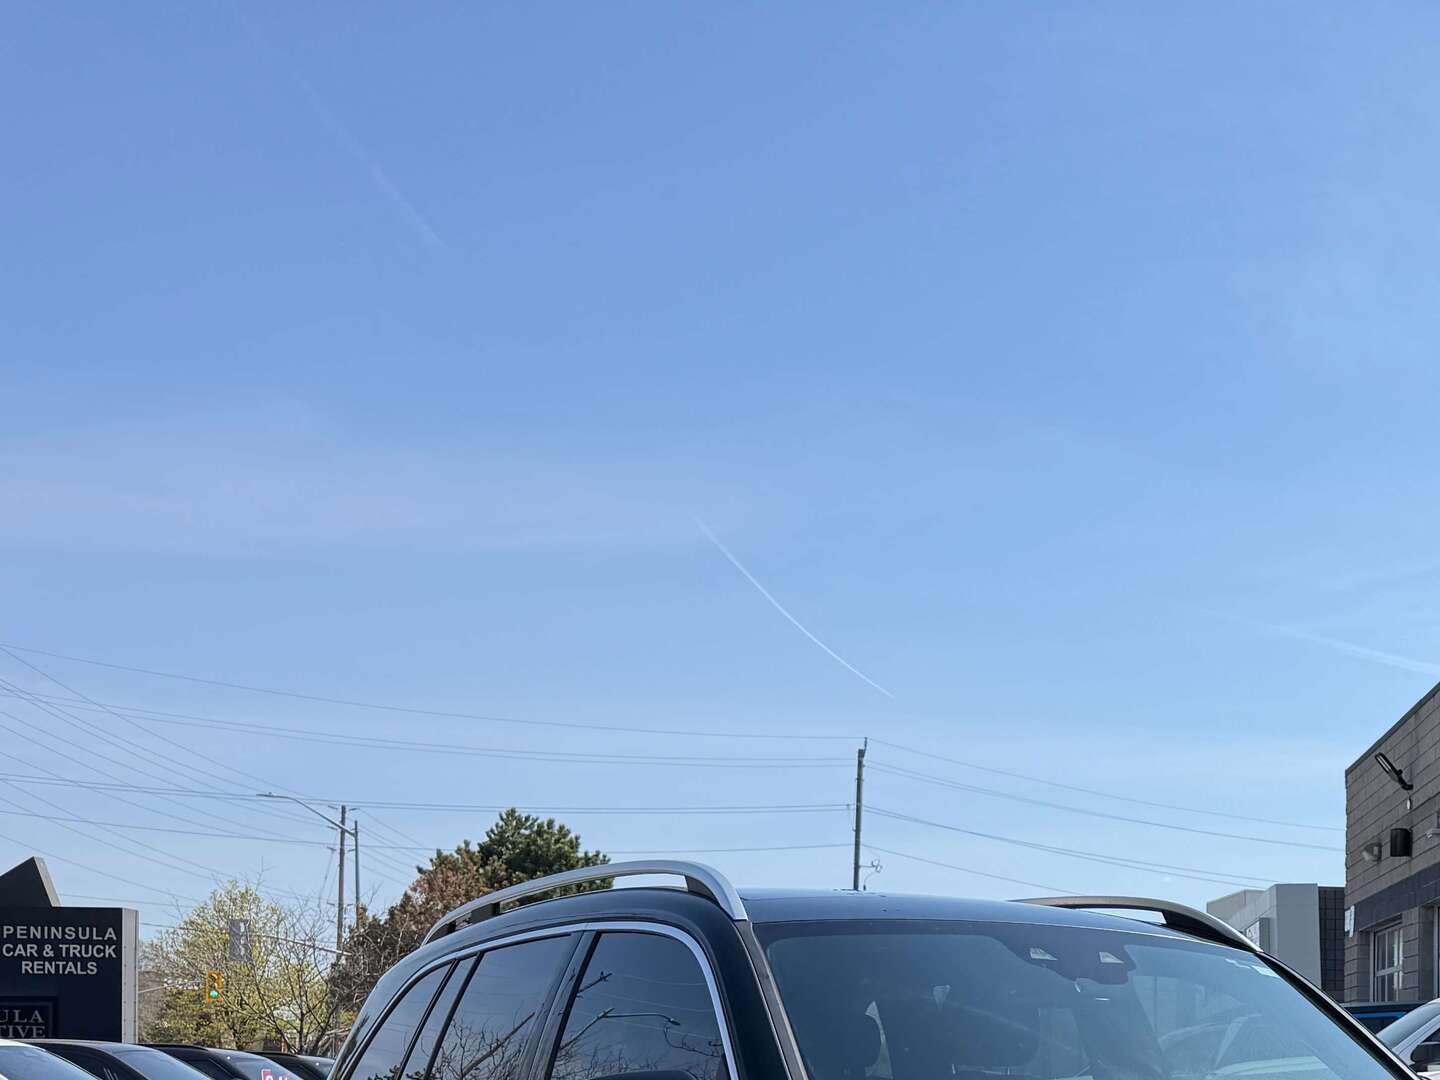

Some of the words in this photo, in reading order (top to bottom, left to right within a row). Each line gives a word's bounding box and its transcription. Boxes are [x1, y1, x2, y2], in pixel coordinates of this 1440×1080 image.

[3, 925, 117, 940] PENINSULA
[2, 943, 38, 957] CAR
[43, 944, 54, 957] &
[59, 944, 117, 958] TRUCK
[21, 961, 98, 975] RENTALS
